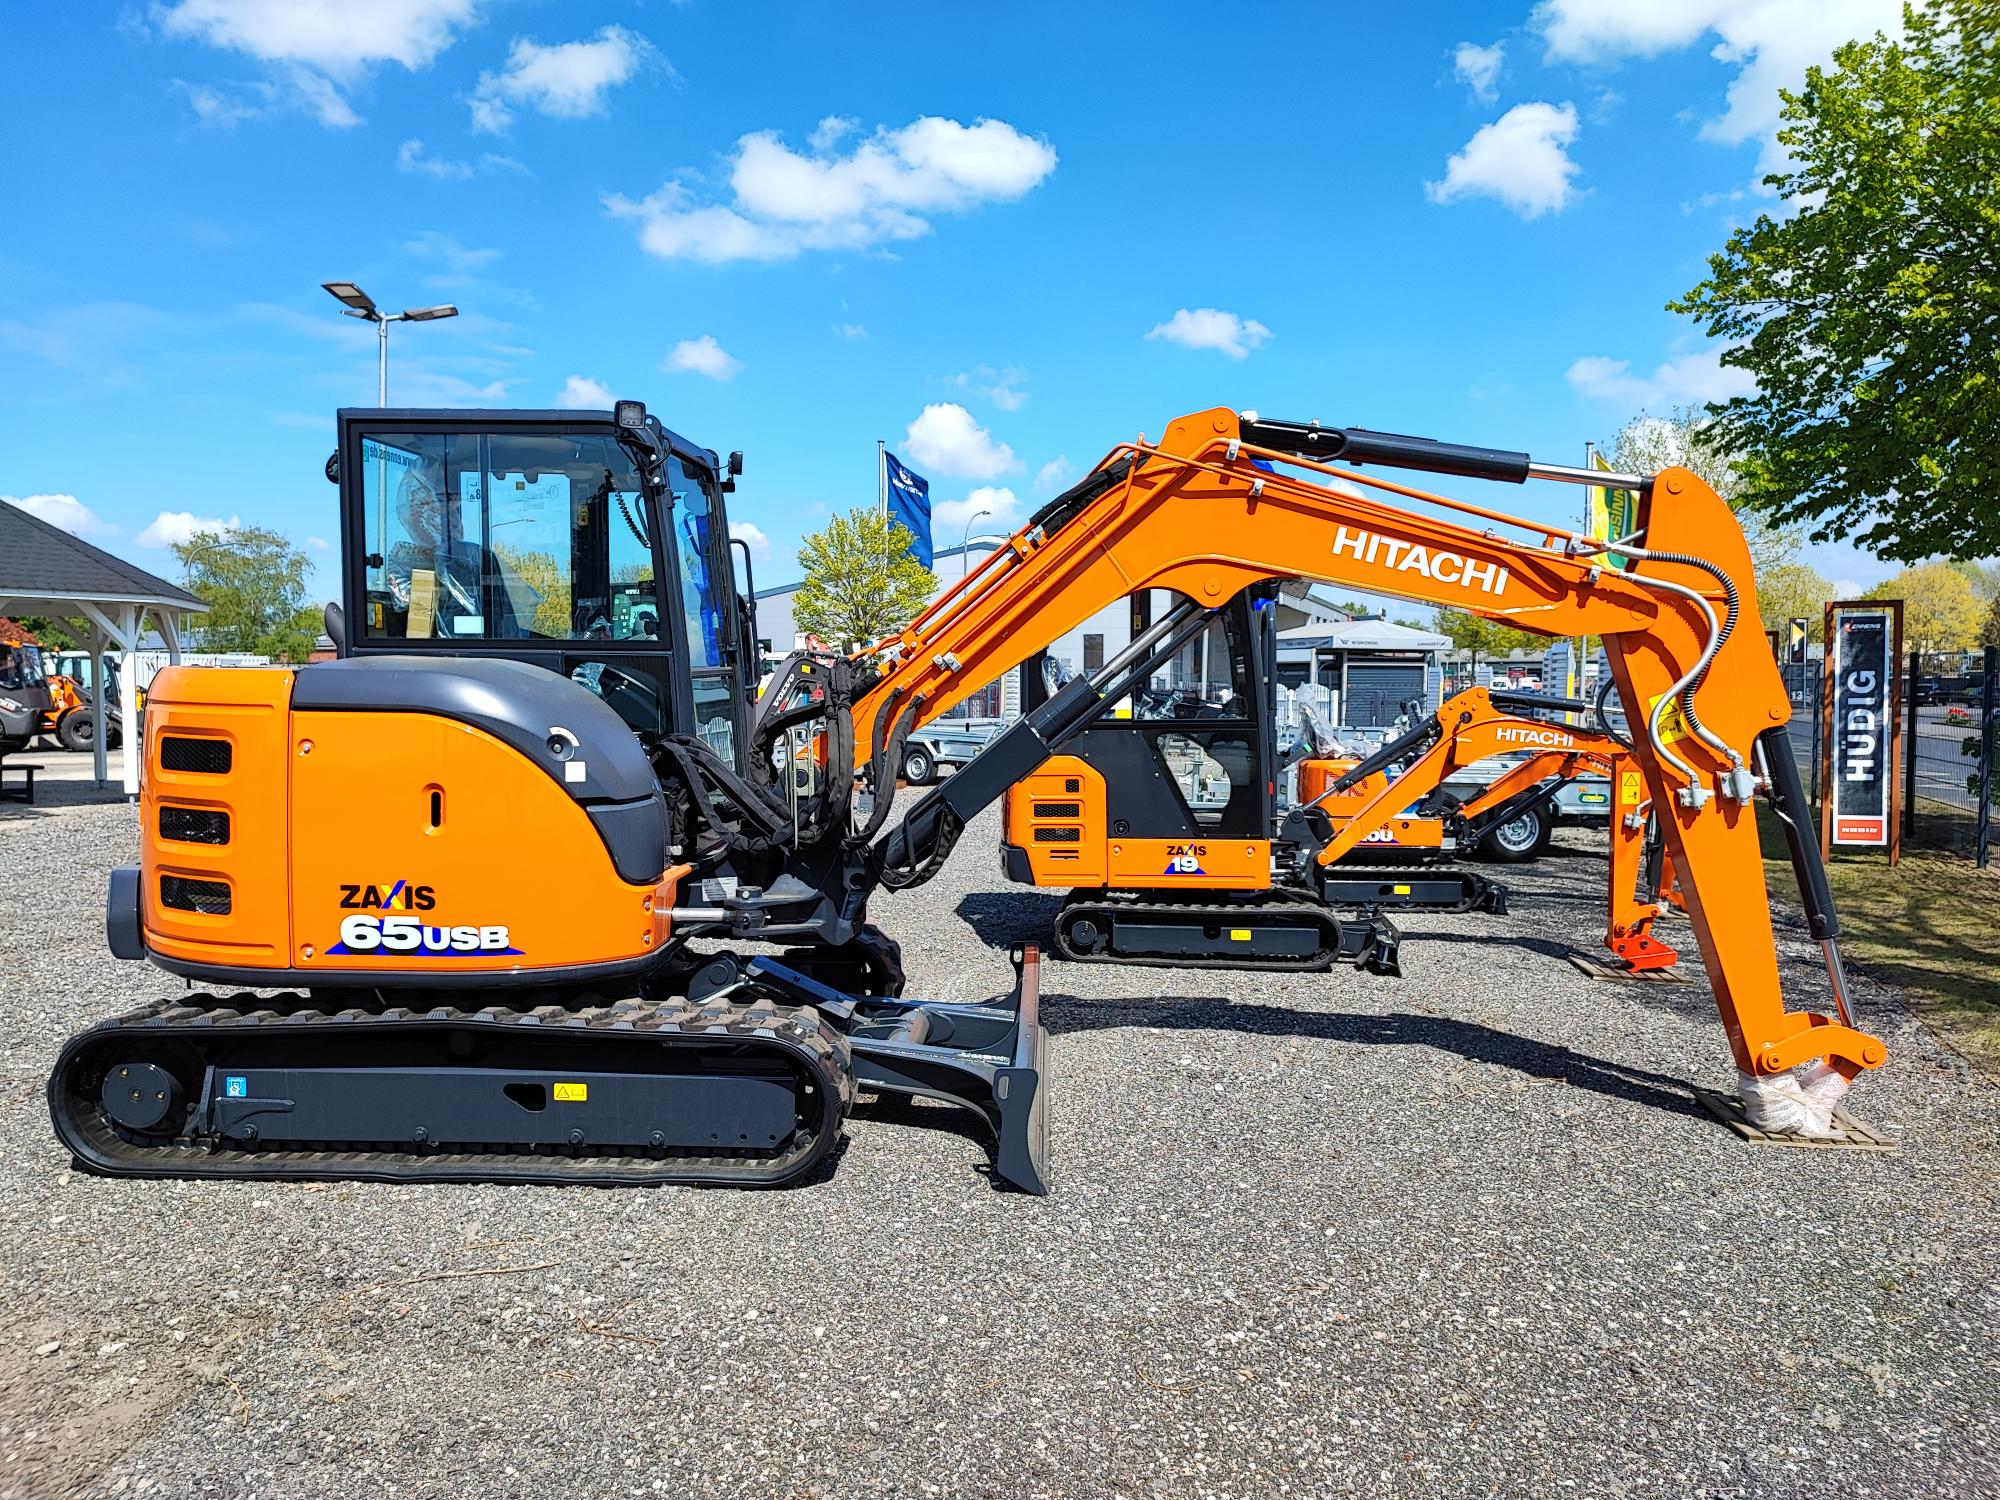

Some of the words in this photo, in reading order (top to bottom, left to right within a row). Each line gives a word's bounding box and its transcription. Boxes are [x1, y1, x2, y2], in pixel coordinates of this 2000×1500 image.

[1332, 526, 1510, 596] HITACHI
[773, 674, 795, 706] VOLVO
[1496, 727, 1574, 747] HITACHI
[1841, 670, 1876, 781] HÜDIG
[1362, 830, 1393, 842] 0U
[1166, 844, 1207, 856] ZAXIS
[1171, 857, 1199, 872] 19
[340, 880, 436, 910] ZAXIS
